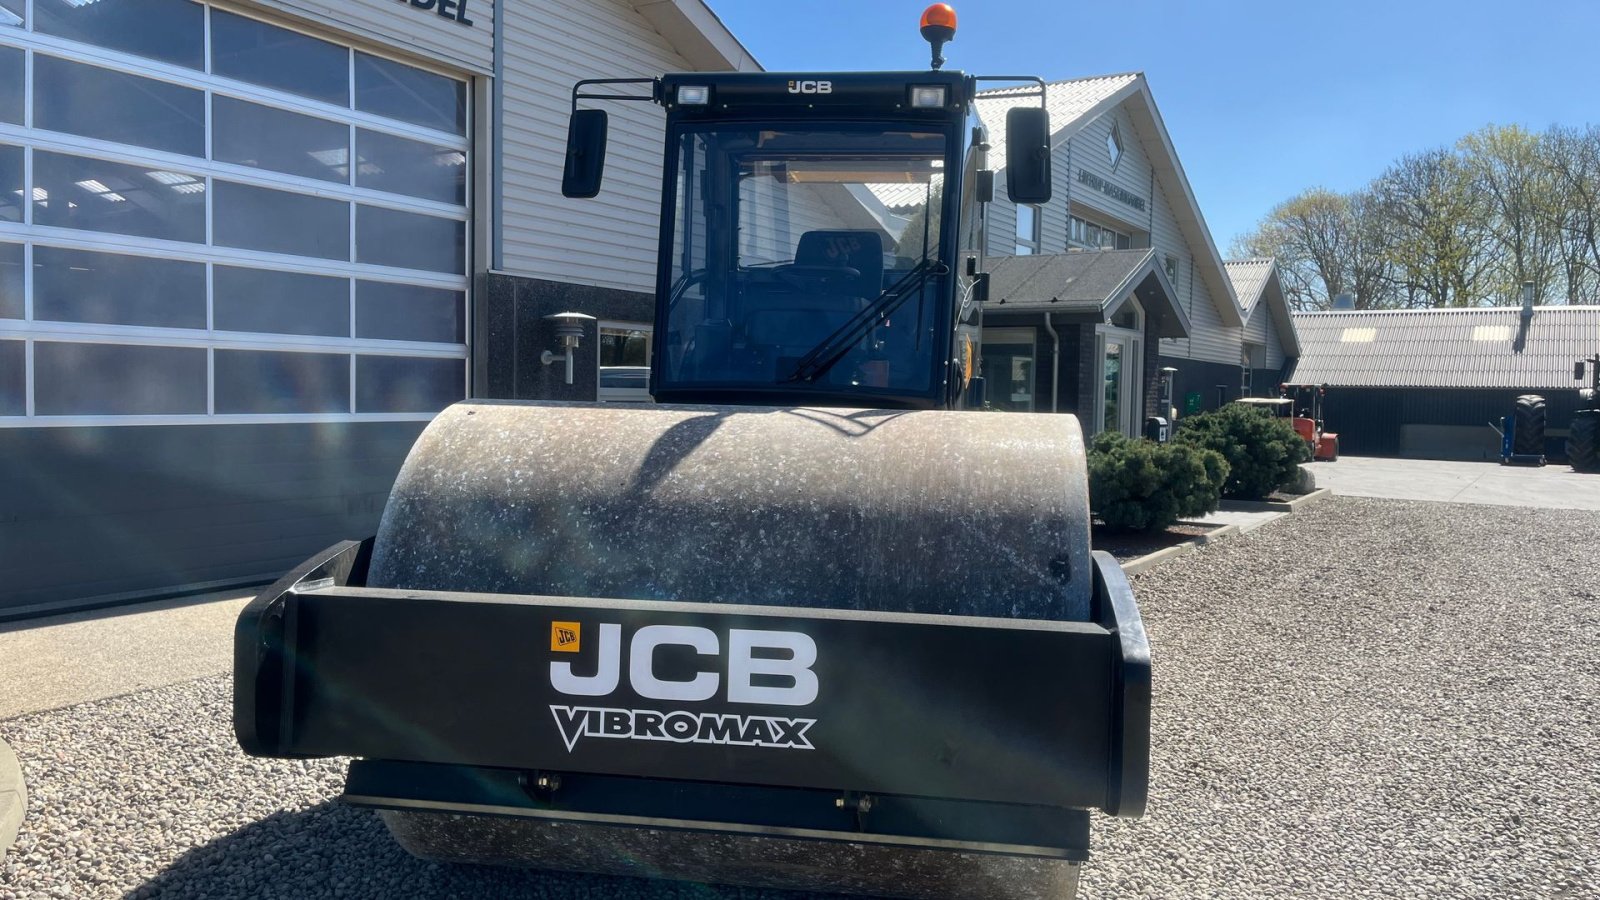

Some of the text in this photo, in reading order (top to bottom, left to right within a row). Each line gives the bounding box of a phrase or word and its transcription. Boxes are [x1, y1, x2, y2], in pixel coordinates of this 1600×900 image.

[788, 80, 832, 93] JCB
[825, 238, 861, 258] JCB
[559, 629, 576, 643] JCB
[550, 623, 819, 706] JCB
[549, 705, 818, 753] VIBROMAX
